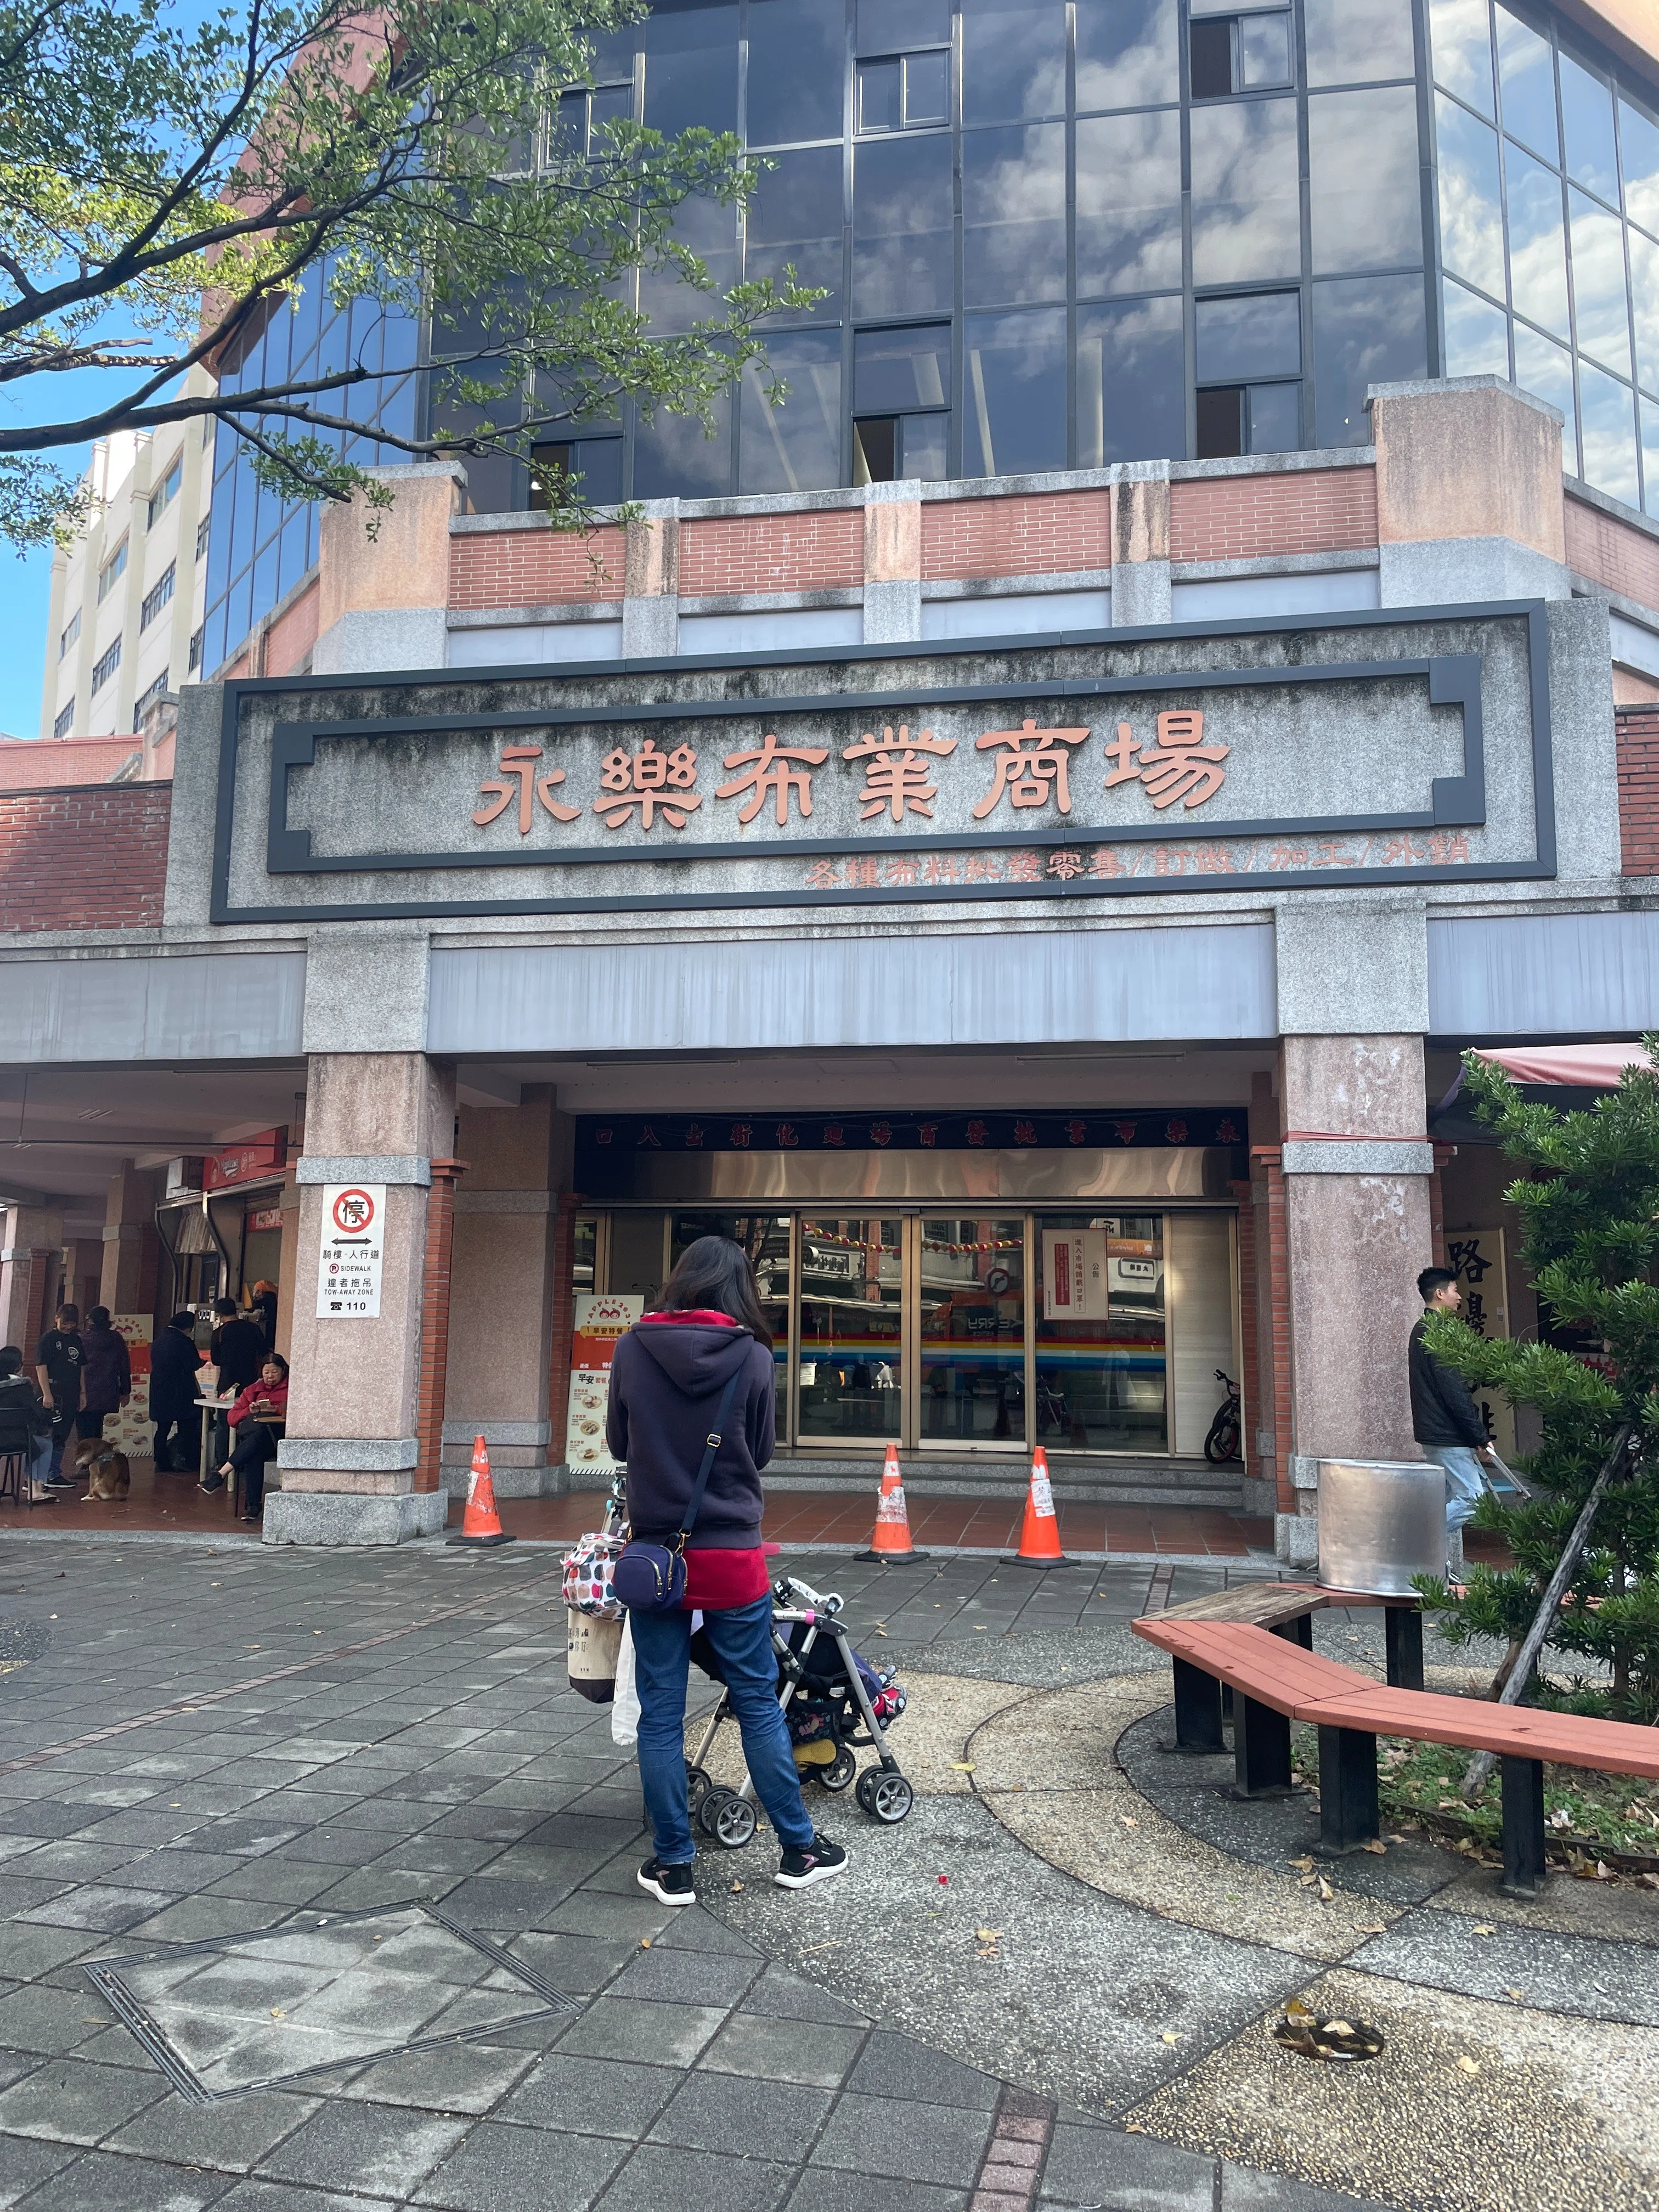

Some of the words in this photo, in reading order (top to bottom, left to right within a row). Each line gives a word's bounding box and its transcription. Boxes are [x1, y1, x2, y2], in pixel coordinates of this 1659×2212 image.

[472, 710, 1230, 834] 永樂布業商場
[1092, 1262, 1099, 1278] 公告
[328, 1278, 371, 1288] 違者拖吊
[347, 1302, 366, 1311] 110
[578, 1373, 595, 1384] 早安
